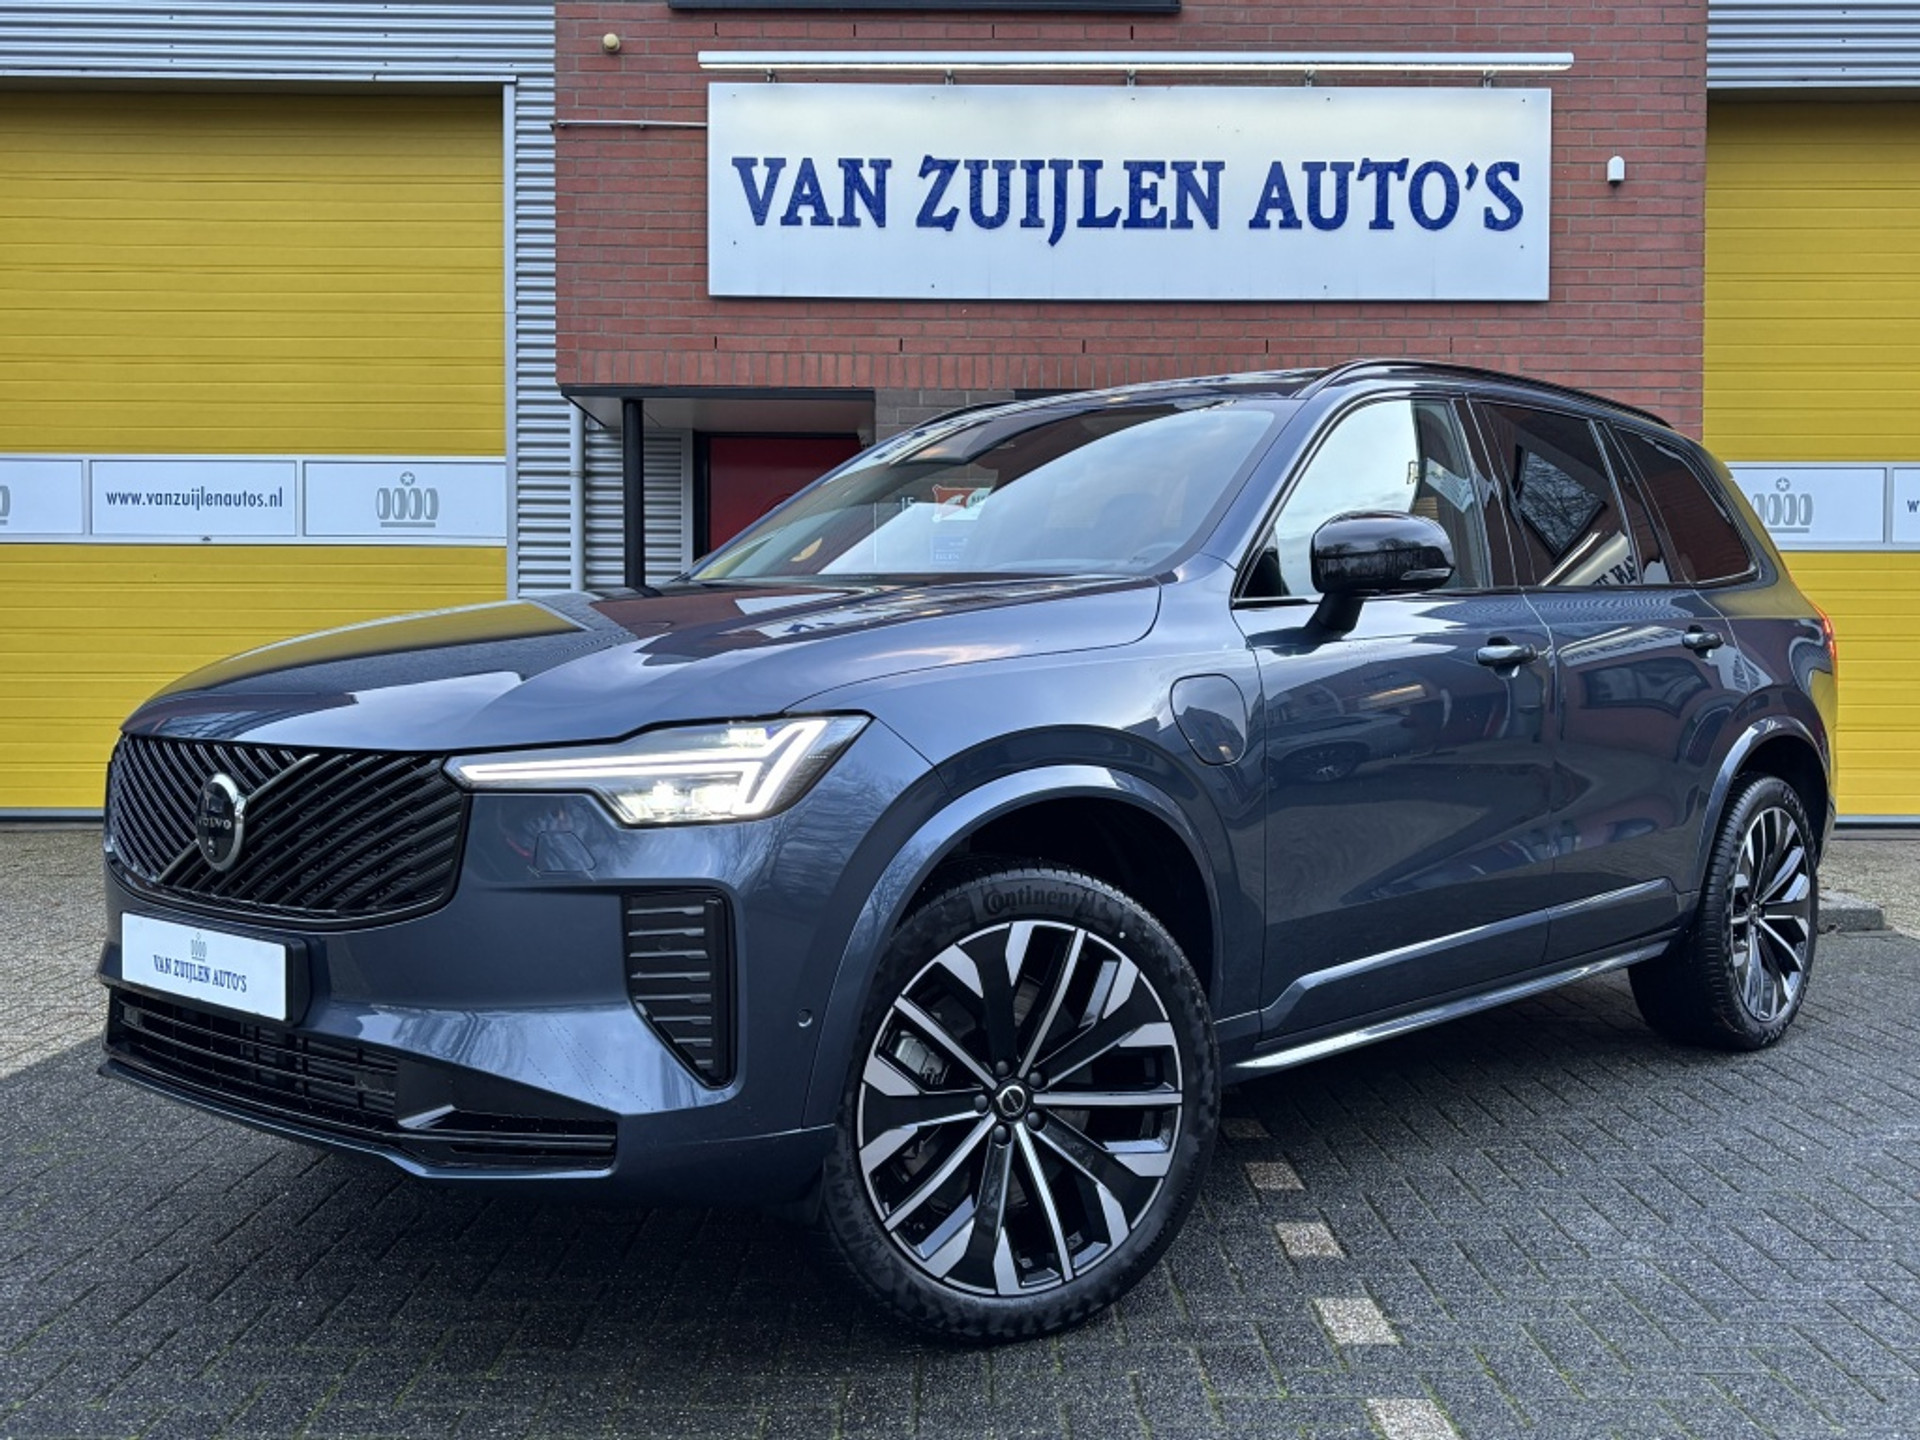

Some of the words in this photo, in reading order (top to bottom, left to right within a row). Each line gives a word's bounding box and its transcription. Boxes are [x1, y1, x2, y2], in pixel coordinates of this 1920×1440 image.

[732, 157, 892, 229] VAN
[916, 155, 1226, 247] ZUIJLEN
[1248, 157, 1524, 232] AUTO'S
[106, 486, 283, 511] www.vanzuijlenautos.nl
[983, 884, 1097, 917] Continent
[153, 954, 172, 975] VAN
[174, 958, 211, 984] ZUIJLEN
[212, 969, 247, 993] AUTO'S
